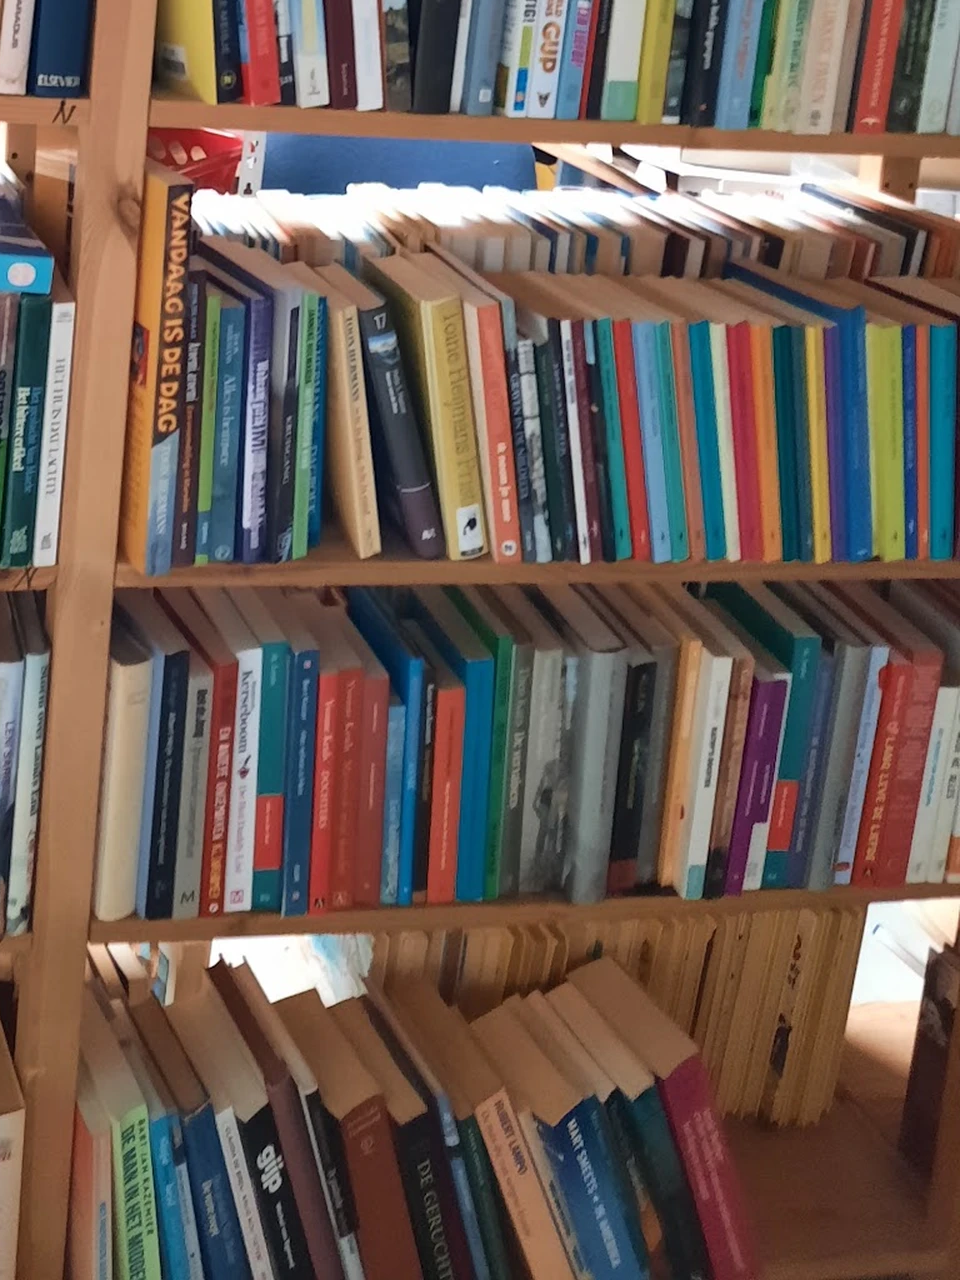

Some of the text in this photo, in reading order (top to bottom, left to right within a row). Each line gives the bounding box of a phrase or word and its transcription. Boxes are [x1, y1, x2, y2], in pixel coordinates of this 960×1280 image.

[155, 192, 191, 434] VANDAAG IS DE DAG
[442, 311, 472, 452] Toine Heijmans
[565, 1119, 585, 1152] MART
[120, 1150, 139, 1185] MAN
[255, 1144, 286, 1194] gijp
[416, 1159, 435, 1189] DE
[123, 1187, 140, 1203] IN
[124, 1205, 144, 1234] HET
